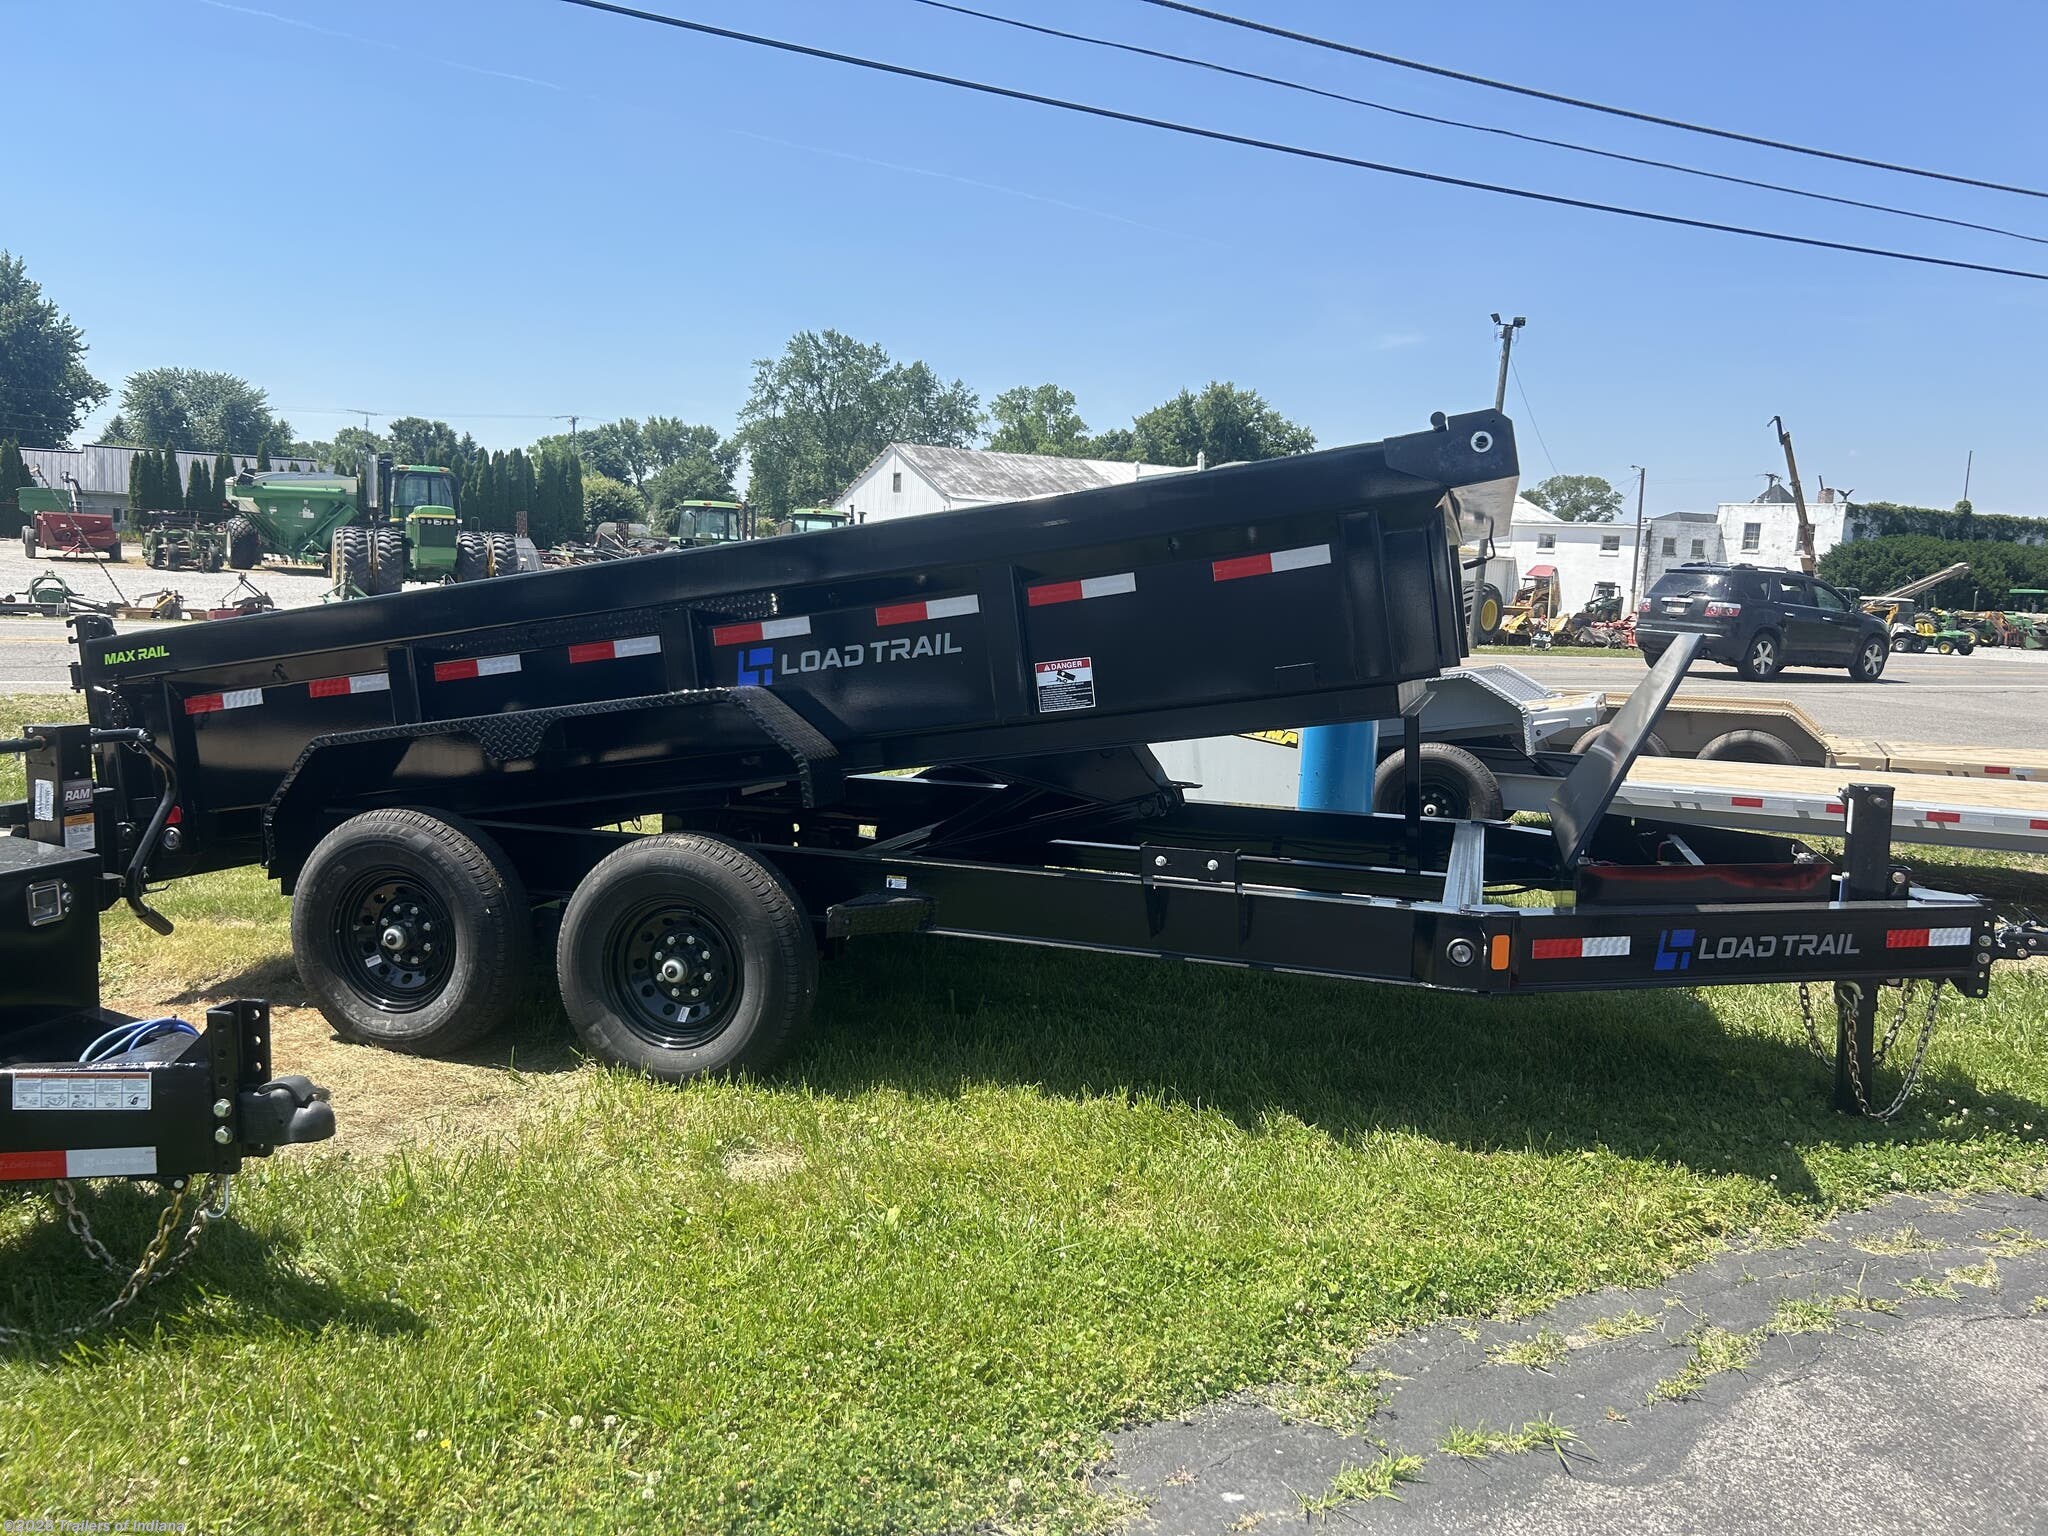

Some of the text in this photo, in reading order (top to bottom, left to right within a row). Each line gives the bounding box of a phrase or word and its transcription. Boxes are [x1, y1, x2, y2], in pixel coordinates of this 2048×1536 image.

[104, 645, 170, 665] MAX RAIL
[781, 632, 963, 675] LOAD TRAIL
[1051, 660, 1083, 671] DANGER
[65, 787, 91, 801] RAM
[1698, 933, 1860, 960] LOAD TRAIL
